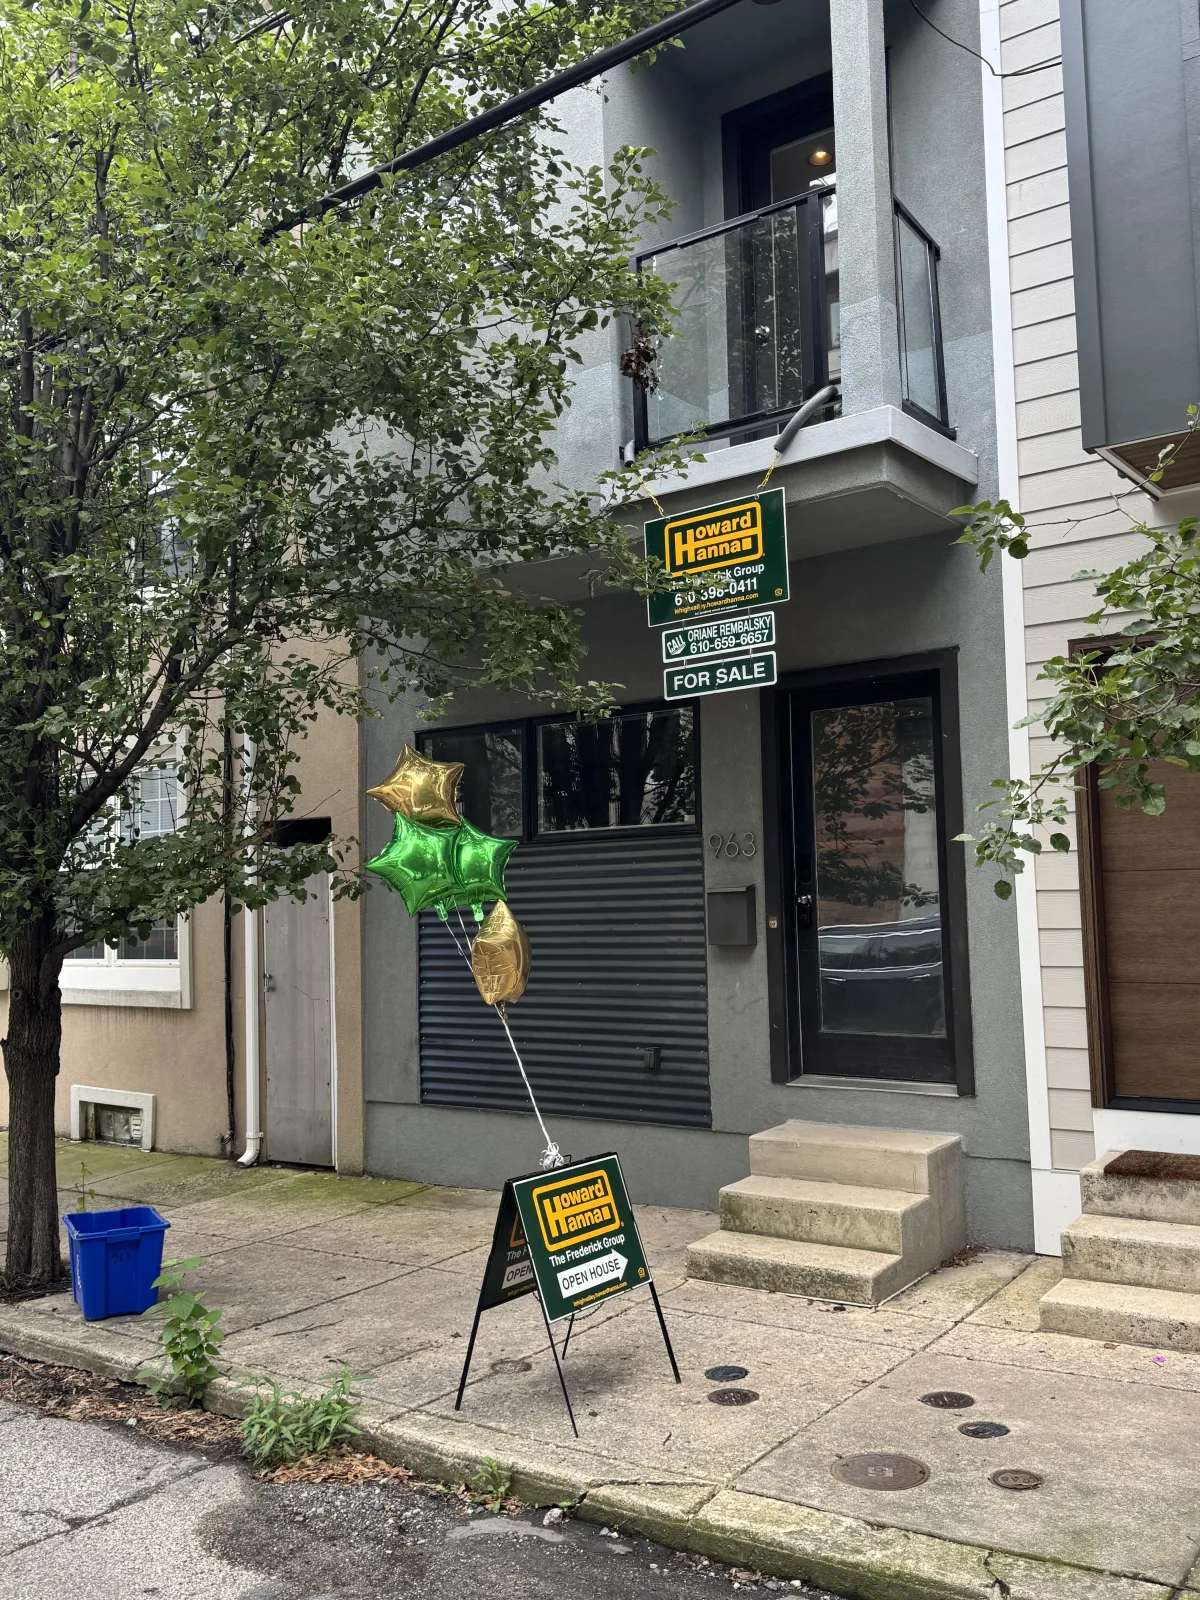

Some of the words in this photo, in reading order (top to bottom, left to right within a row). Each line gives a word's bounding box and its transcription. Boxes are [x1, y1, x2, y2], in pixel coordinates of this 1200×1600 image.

[674, 511, 752, 554] Howard
[674, 531, 743, 566] Hanna
[733, 563, 765, 578] Group
[687, 625, 718, 642] ORIANE
[719, 615, 772, 637] REMBALSKY
[690, 630, 769, 654] 610-659-6657
[666, 634, 686, 653] CALL
[673, 671, 711, 691] FOR
[715, 662, 766, 684] SALE
[708, 831, 756, 858] 963
[543, 1179, 605, 1221] Howard
[543, 1202, 604, 1238] Hanna
[506, 1250, 521, 1261] The
[549, 1255, 566, 1268] The
[566, 1241, 603, 1262] Frederick
[602, 1233, 625, 1250] Group
[506, 1265, 532, 1282] OPEN
[562, 1271, 589, 1291] OPEN
[589, 1258, 621, 1277] HOUSE
